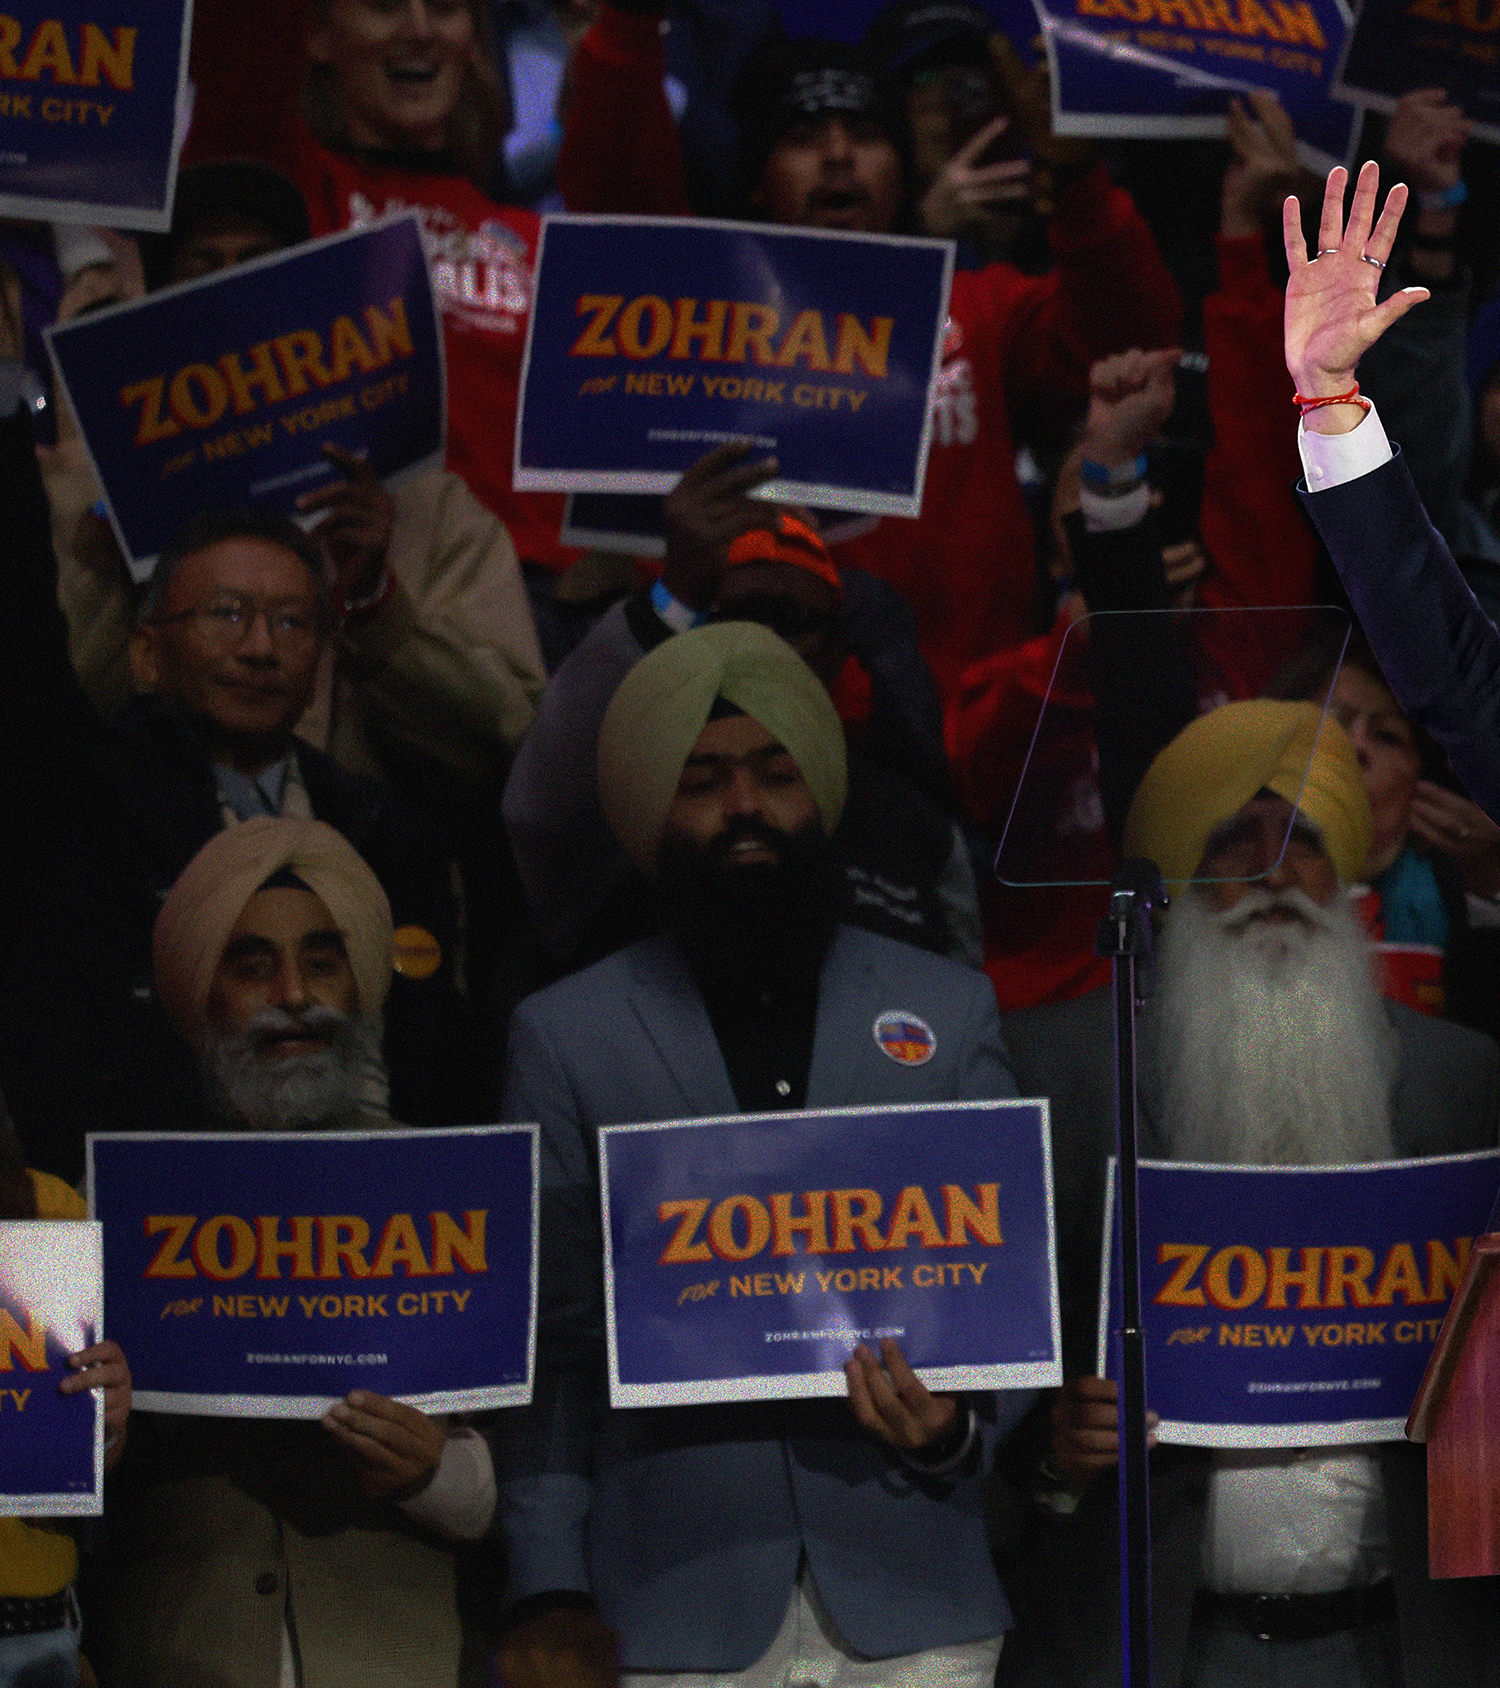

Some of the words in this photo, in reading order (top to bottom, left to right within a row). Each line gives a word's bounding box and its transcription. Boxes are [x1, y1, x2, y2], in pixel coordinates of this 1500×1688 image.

[40, 95, 117, 127] CITY
[119, 295, 416, 449] ZOHRAN
[568, 293, 897, 379] ZOHRAN
[202, 421, 275, 462] NEW
[279, 394, 359, 437] YORK
[358, 370, 411, 413] CITY
[623, 370, 696, 398] NEW
[701, 374, 786, 405] YORK
[791, 383, 869, 414] CITY
[142, 1207, 490, 1282] ZOHRAN
[656, 1181, 1005, 1267] ZOHRAN
[211, 1294, 291, 1319] NEW
[297, 1294, 390, 1319] YORK
[395, 1289, 473, 1317] CITY
[728, 1272, 807, 1299] NEW
[813, 1266, 906, 1294] YORK
[911, 1261, 989, 1289] CITY
[1152, 1235, 1475, 1311] ZOHRAN
[1216, 1323, 1296, 1348] NEW
[1302, 1321, 1388, 1348] YORK
